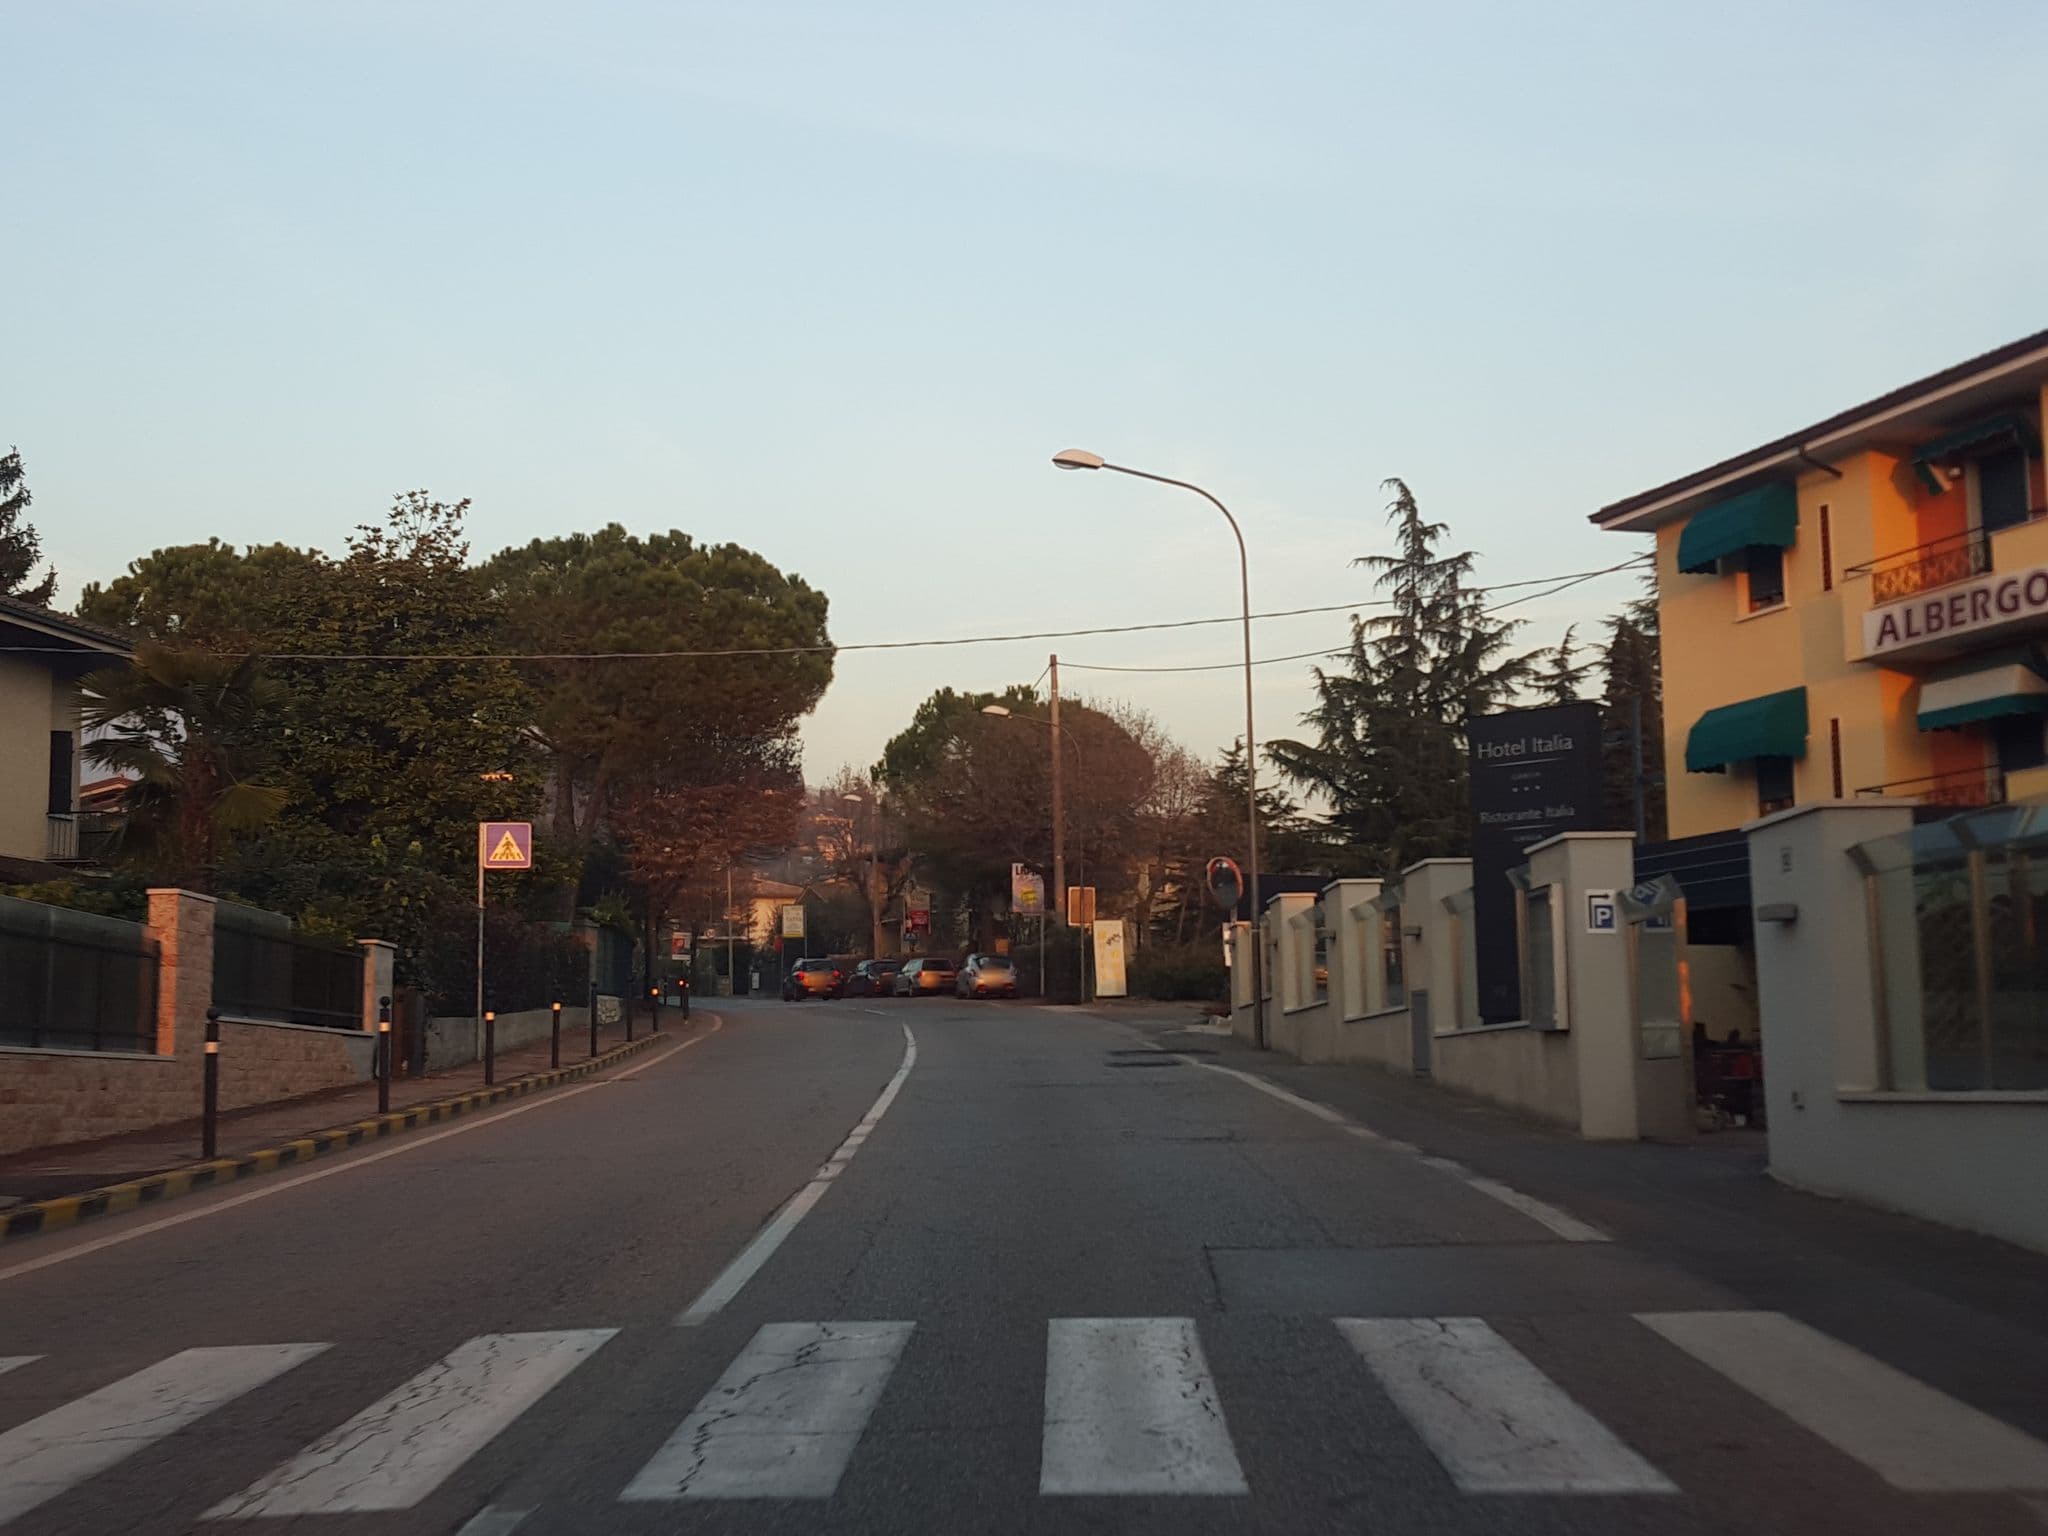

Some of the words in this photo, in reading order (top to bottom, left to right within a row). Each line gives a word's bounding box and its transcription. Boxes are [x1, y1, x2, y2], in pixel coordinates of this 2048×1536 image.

[1876, 572, 2048, 647] ALBERGO
[1477, 738, 1526, 759] Hotel
[1532, 733, 1573, 753] Italia
[1479, 809, 1543, 824] Ristorante
[1545, 804, 1576, 818] Italia
[1596, 908, 1611, 927] P
